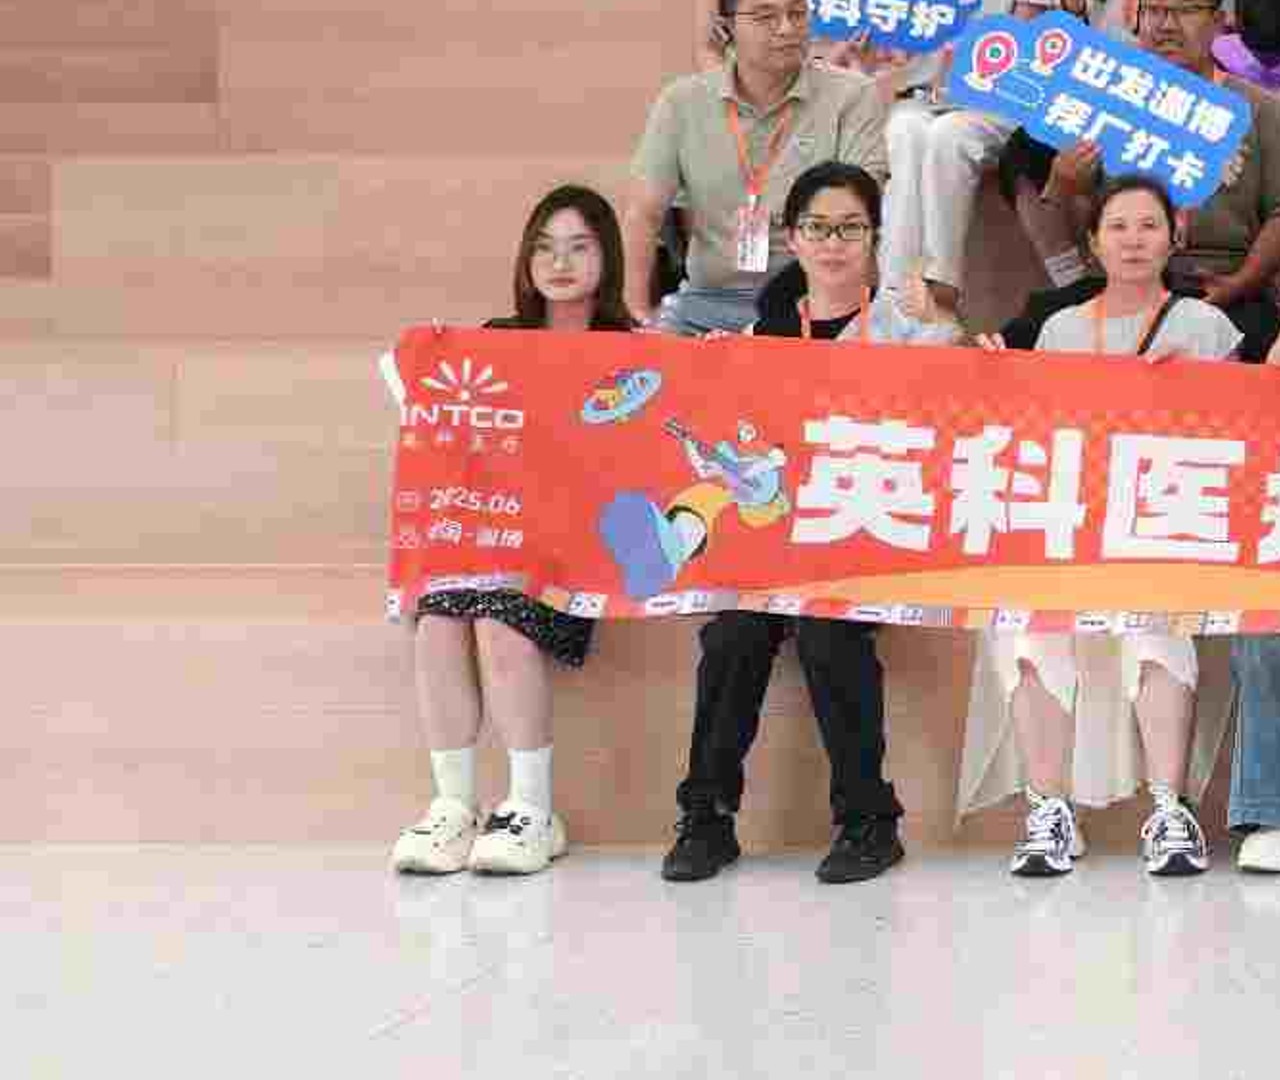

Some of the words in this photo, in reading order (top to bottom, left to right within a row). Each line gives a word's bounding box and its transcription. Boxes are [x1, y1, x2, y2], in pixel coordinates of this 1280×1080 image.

[1044, 92, 1206, 189] 探厂打卡
[1071, 46, 1235, 143] 出发淄博
[400, 404, 523, 428] INTCO
